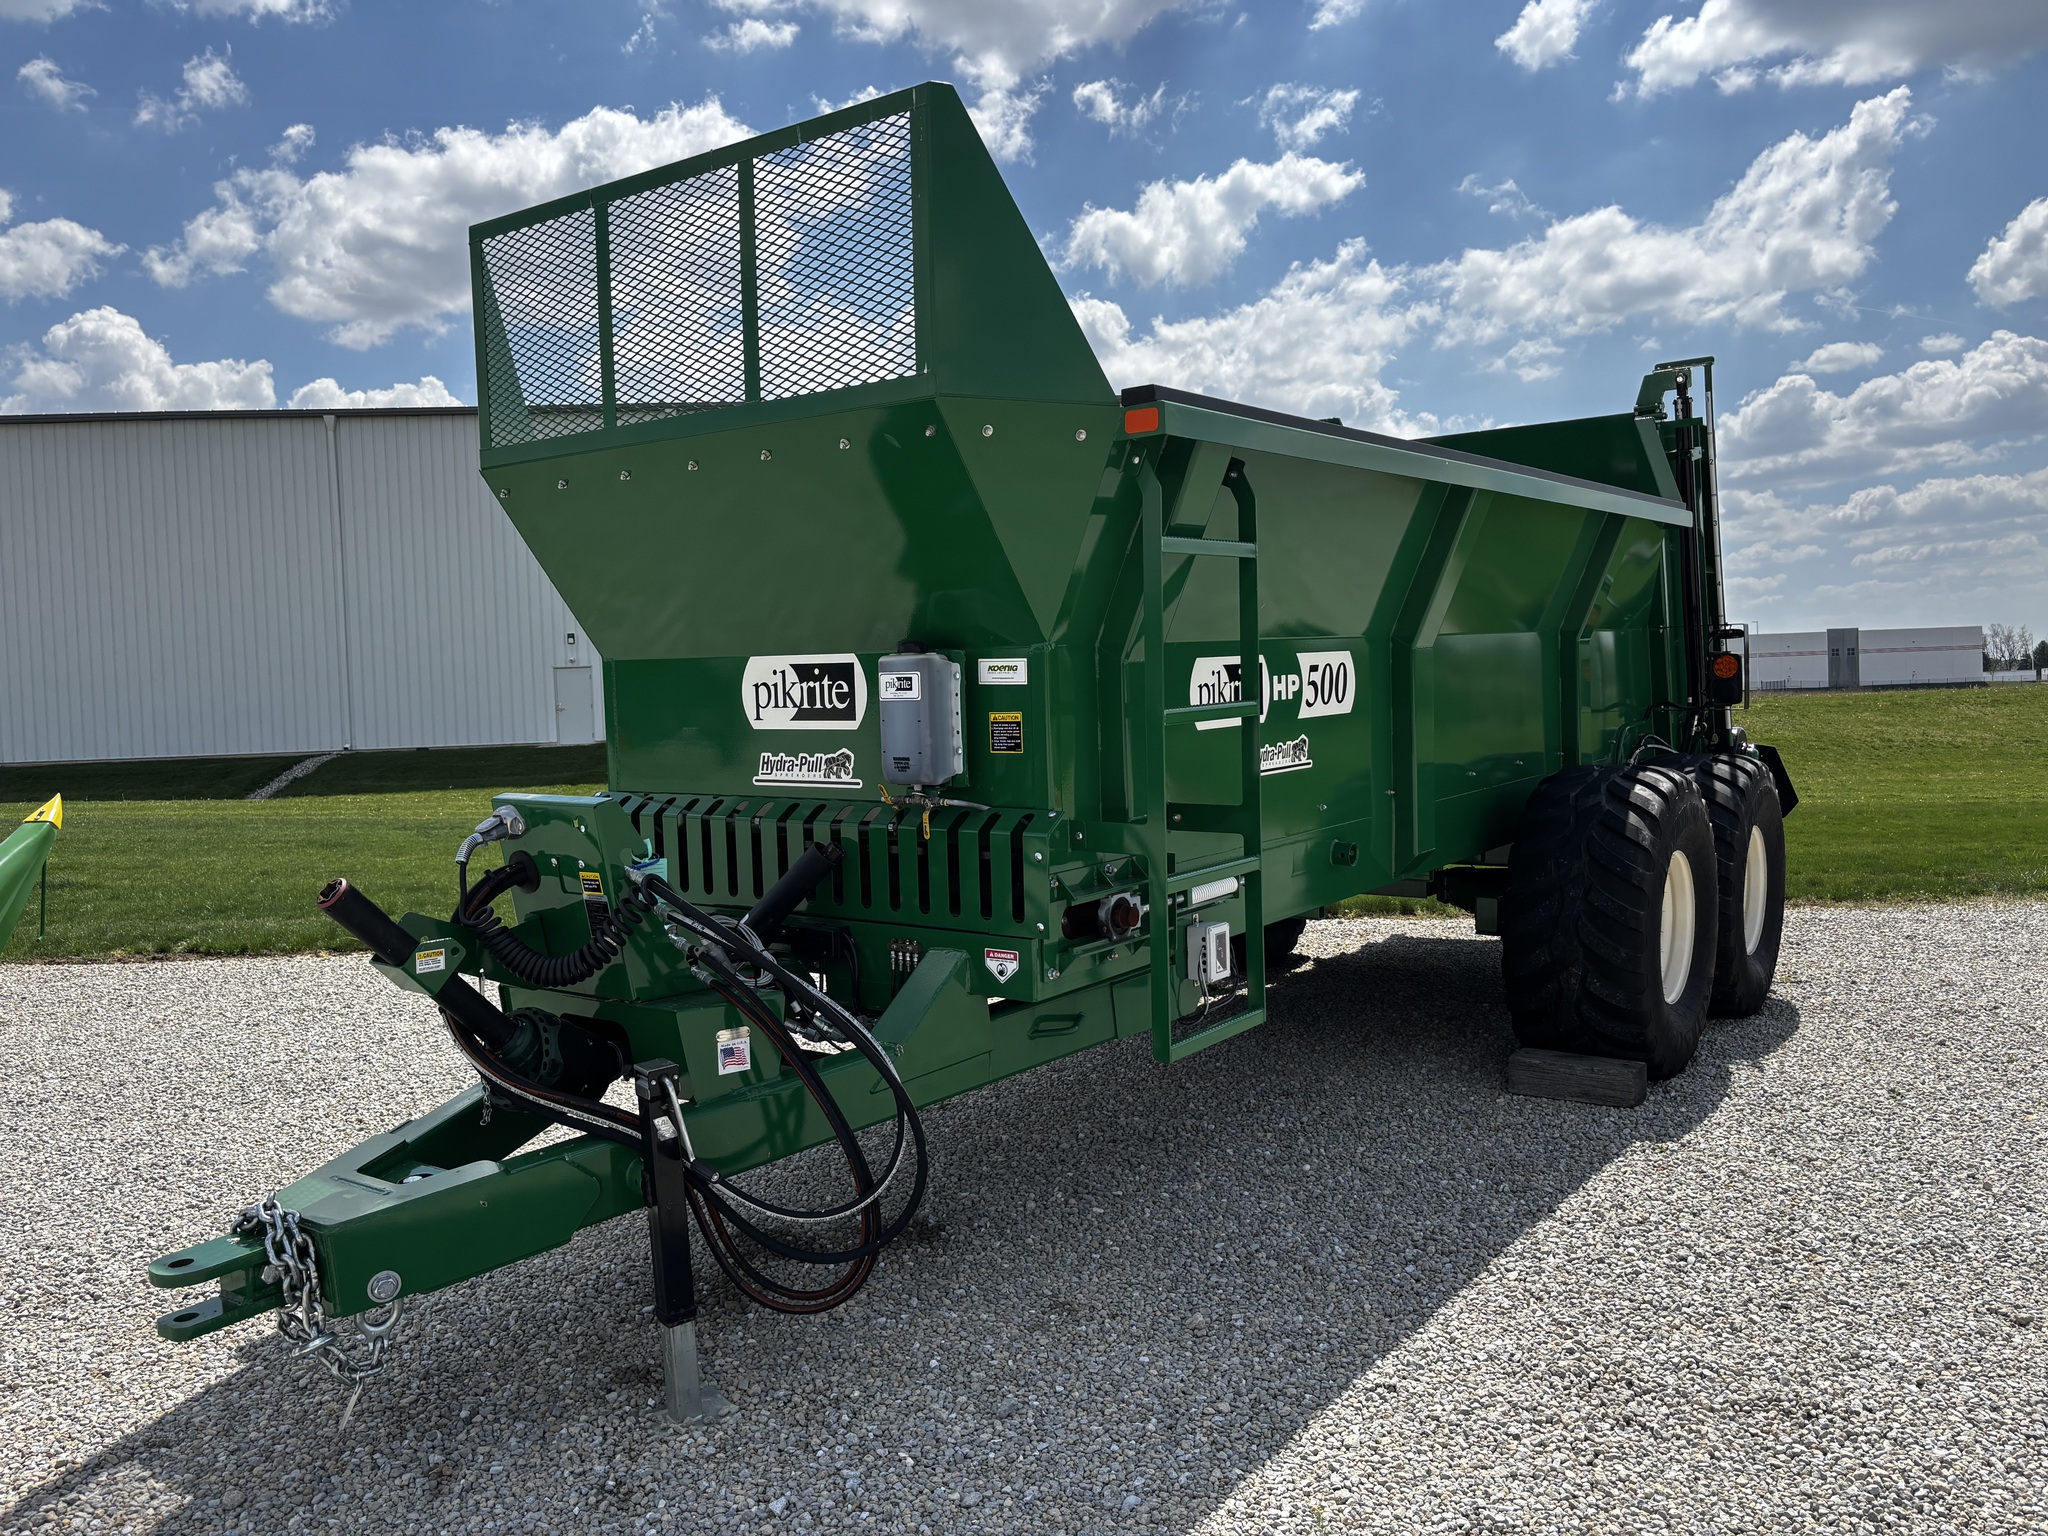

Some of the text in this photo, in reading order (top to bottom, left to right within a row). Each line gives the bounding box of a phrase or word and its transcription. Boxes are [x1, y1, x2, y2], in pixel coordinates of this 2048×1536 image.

[885, 677, 912, 691] pikrite
[1273, 662, 1348, 708] HP 500
[752, 668, 850, 721] pikrite
[761, 755, 823, 775] Hydra-Pull
[423, 950, 444, 959] CAUTION
[994, 952, 1015, 960] DANGER
